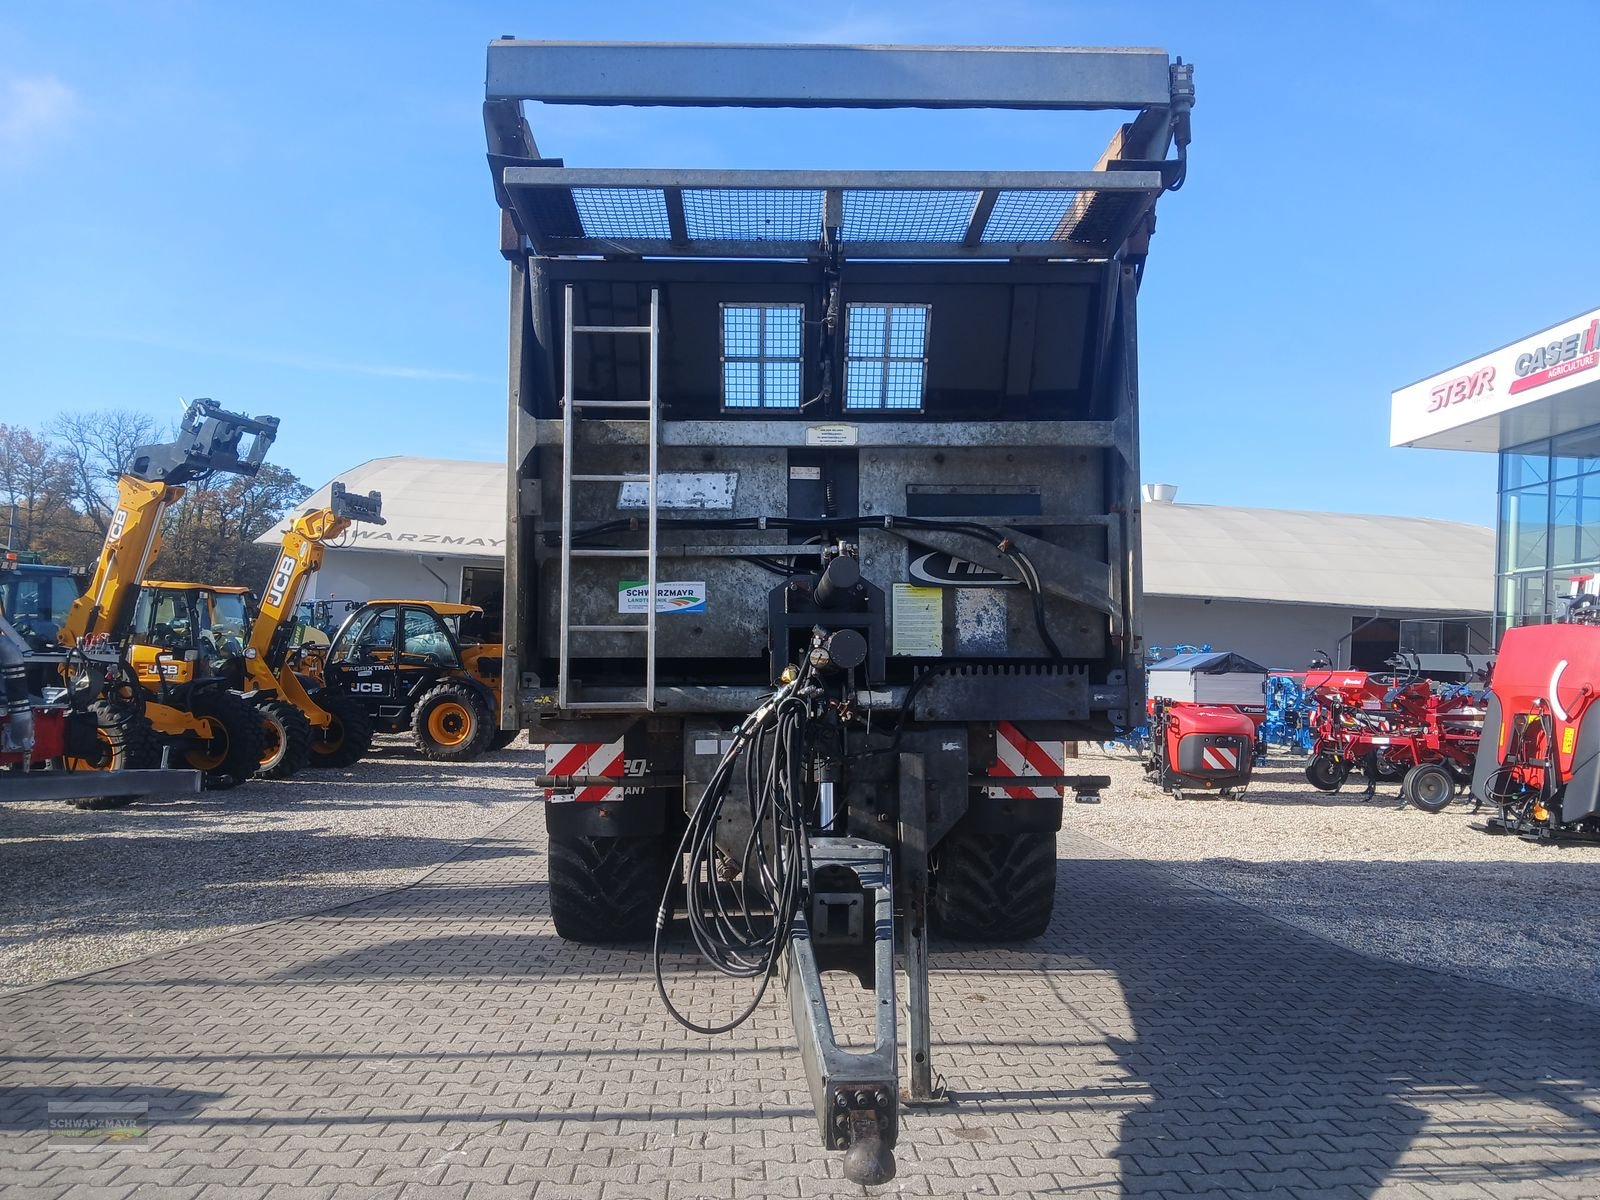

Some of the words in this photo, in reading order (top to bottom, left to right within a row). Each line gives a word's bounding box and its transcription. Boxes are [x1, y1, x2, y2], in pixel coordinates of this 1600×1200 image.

[1515, 333, 1580, 377] CASE
[1548, 355, 1594, 379] AGRICULTURE
[1427, 366, 1496, 413] STEYR
[266, 556, 296, 606] JCB
[350, 682, 383, 693] JCB
